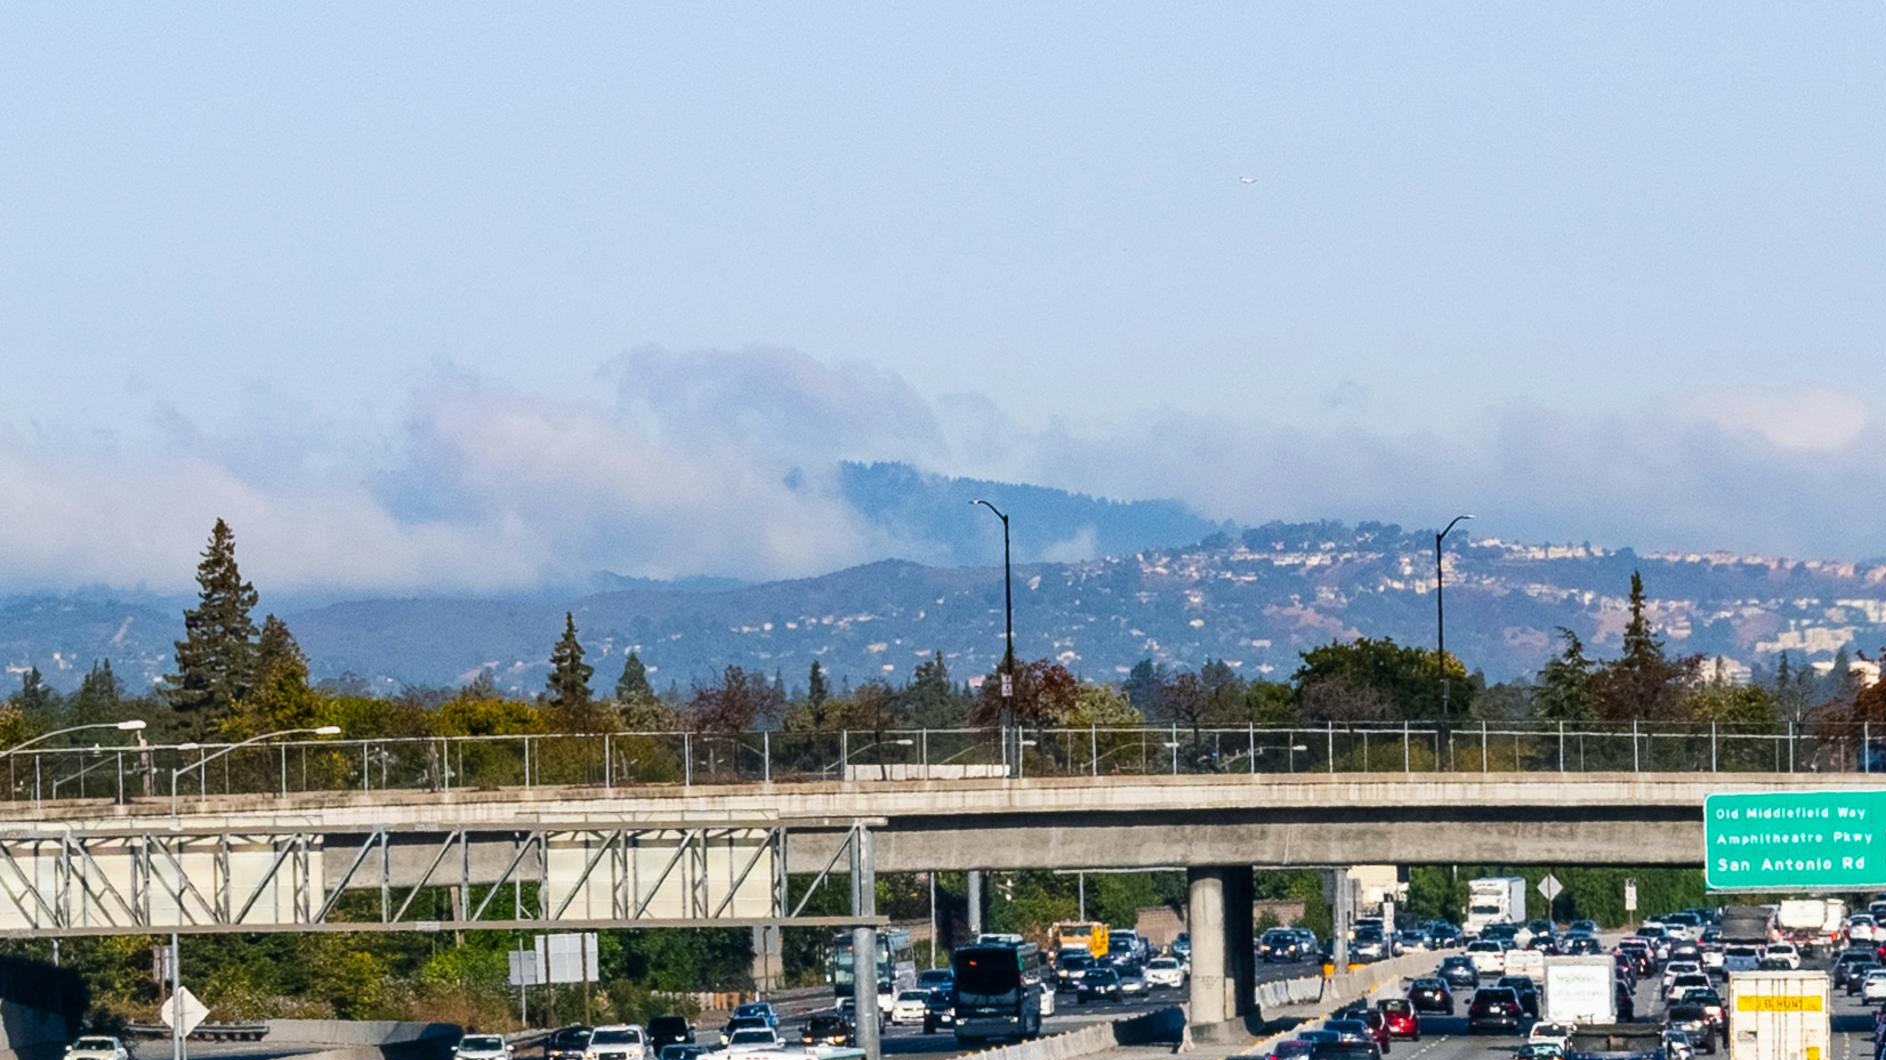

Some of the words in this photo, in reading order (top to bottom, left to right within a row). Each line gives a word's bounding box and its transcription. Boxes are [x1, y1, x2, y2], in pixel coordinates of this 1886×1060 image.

[1716, 808, 1739, 820] Old
[1746, 807, 1830, 819] Middlefield
[1837, 807, 1866, 820] Way
[1716, 832, 1823, 846] Amphitheatre
[1833, 831, 1872, 844] Pkwy
[1717, 858, 1751, 872] San
[1761, 857, 1832, 872] Antonio
[1842, 856, 1866, 870] Rd
[1776, 999, 1803, 1009] HUNT
